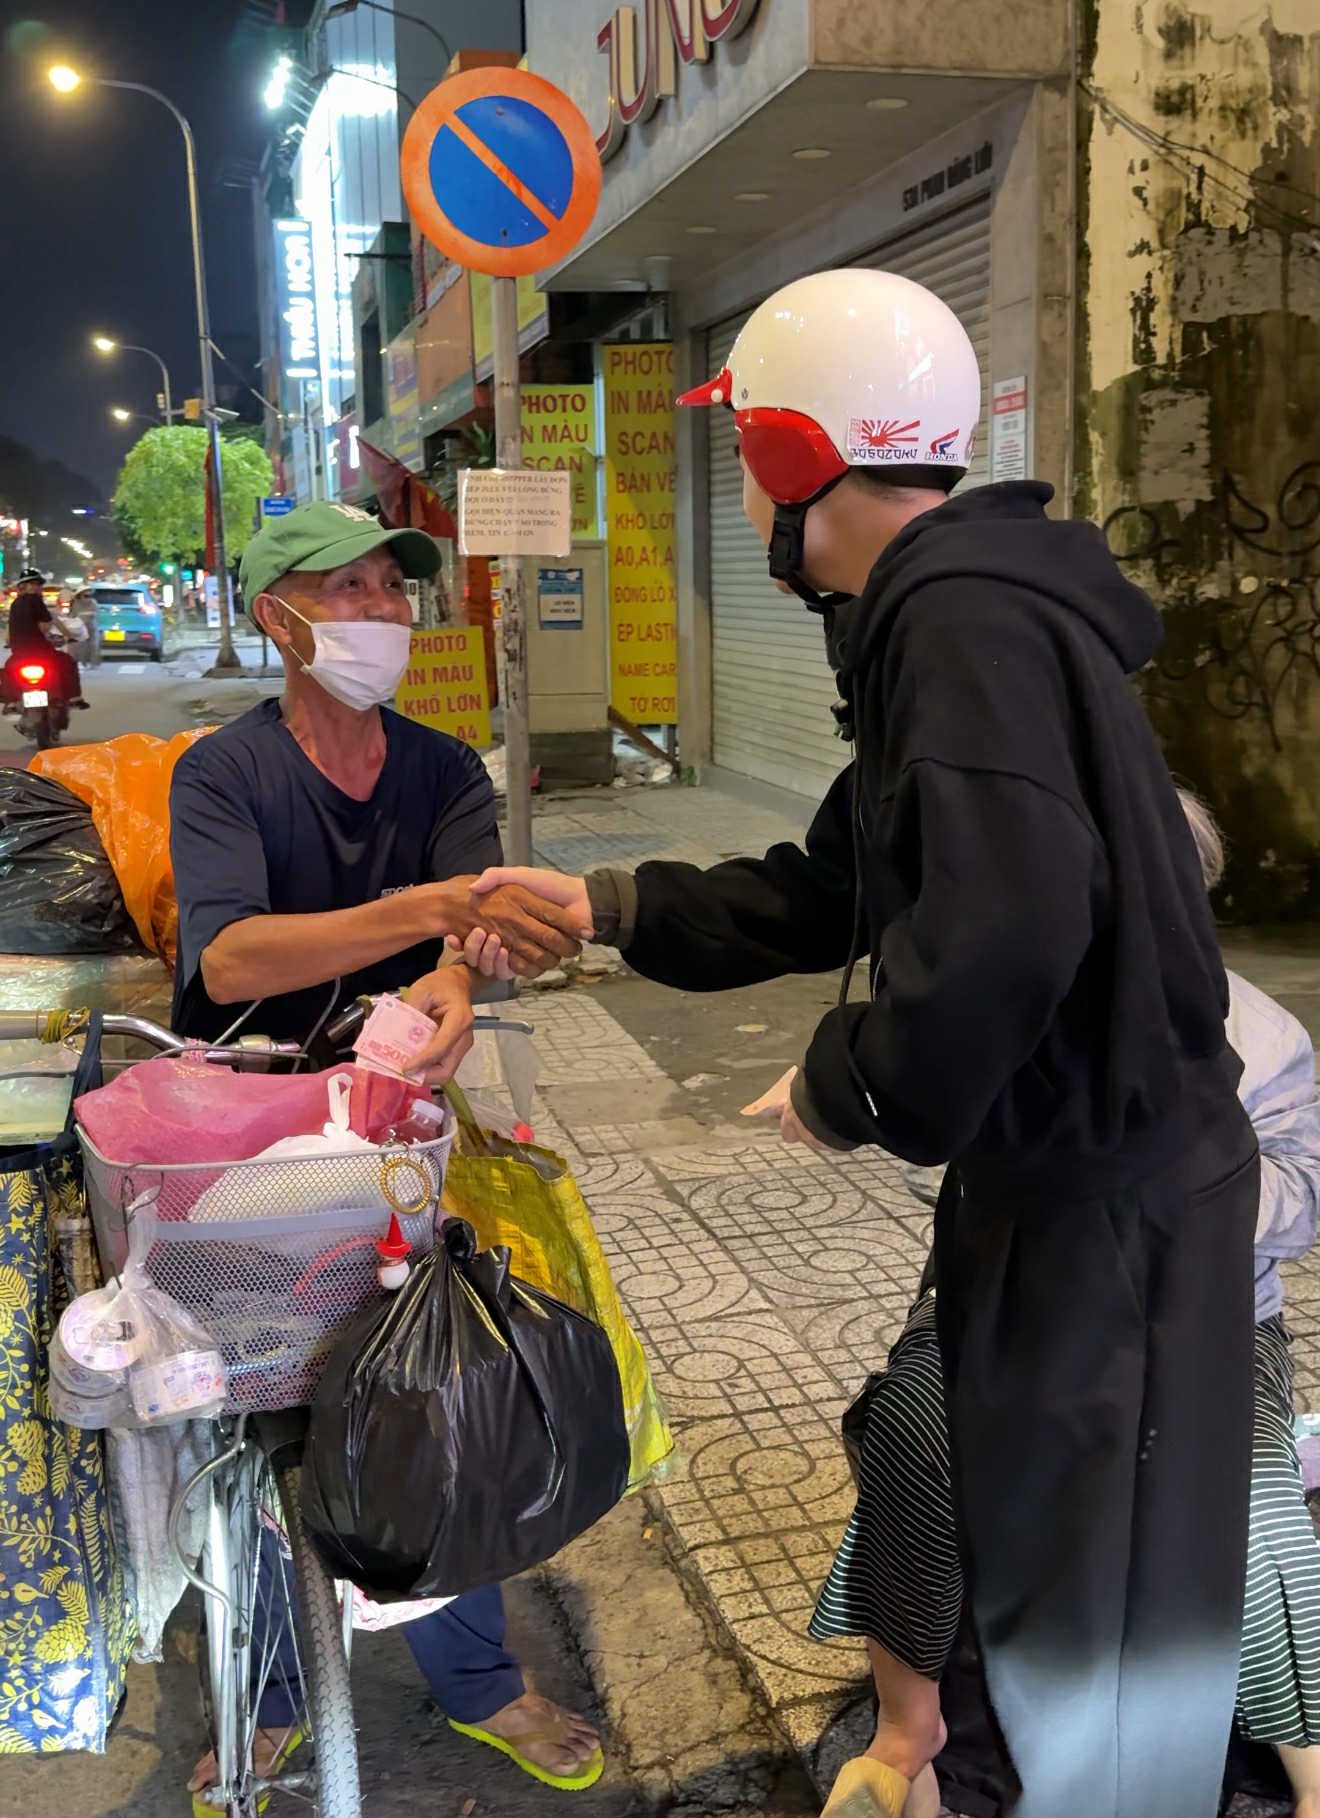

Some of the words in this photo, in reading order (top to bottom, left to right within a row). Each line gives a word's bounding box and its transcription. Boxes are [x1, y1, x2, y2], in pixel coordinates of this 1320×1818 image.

[610, 390, 630, 414] IN
[520, 425, 535, 444] N
[541, 418, 589, 444] MÀU
[614, 545, 675, 569] A0,A1,A
[409, 634, 467, 655] PHOTO
[406, 668, 426, 686] IN
[618, 663, 650, 678] NAME
